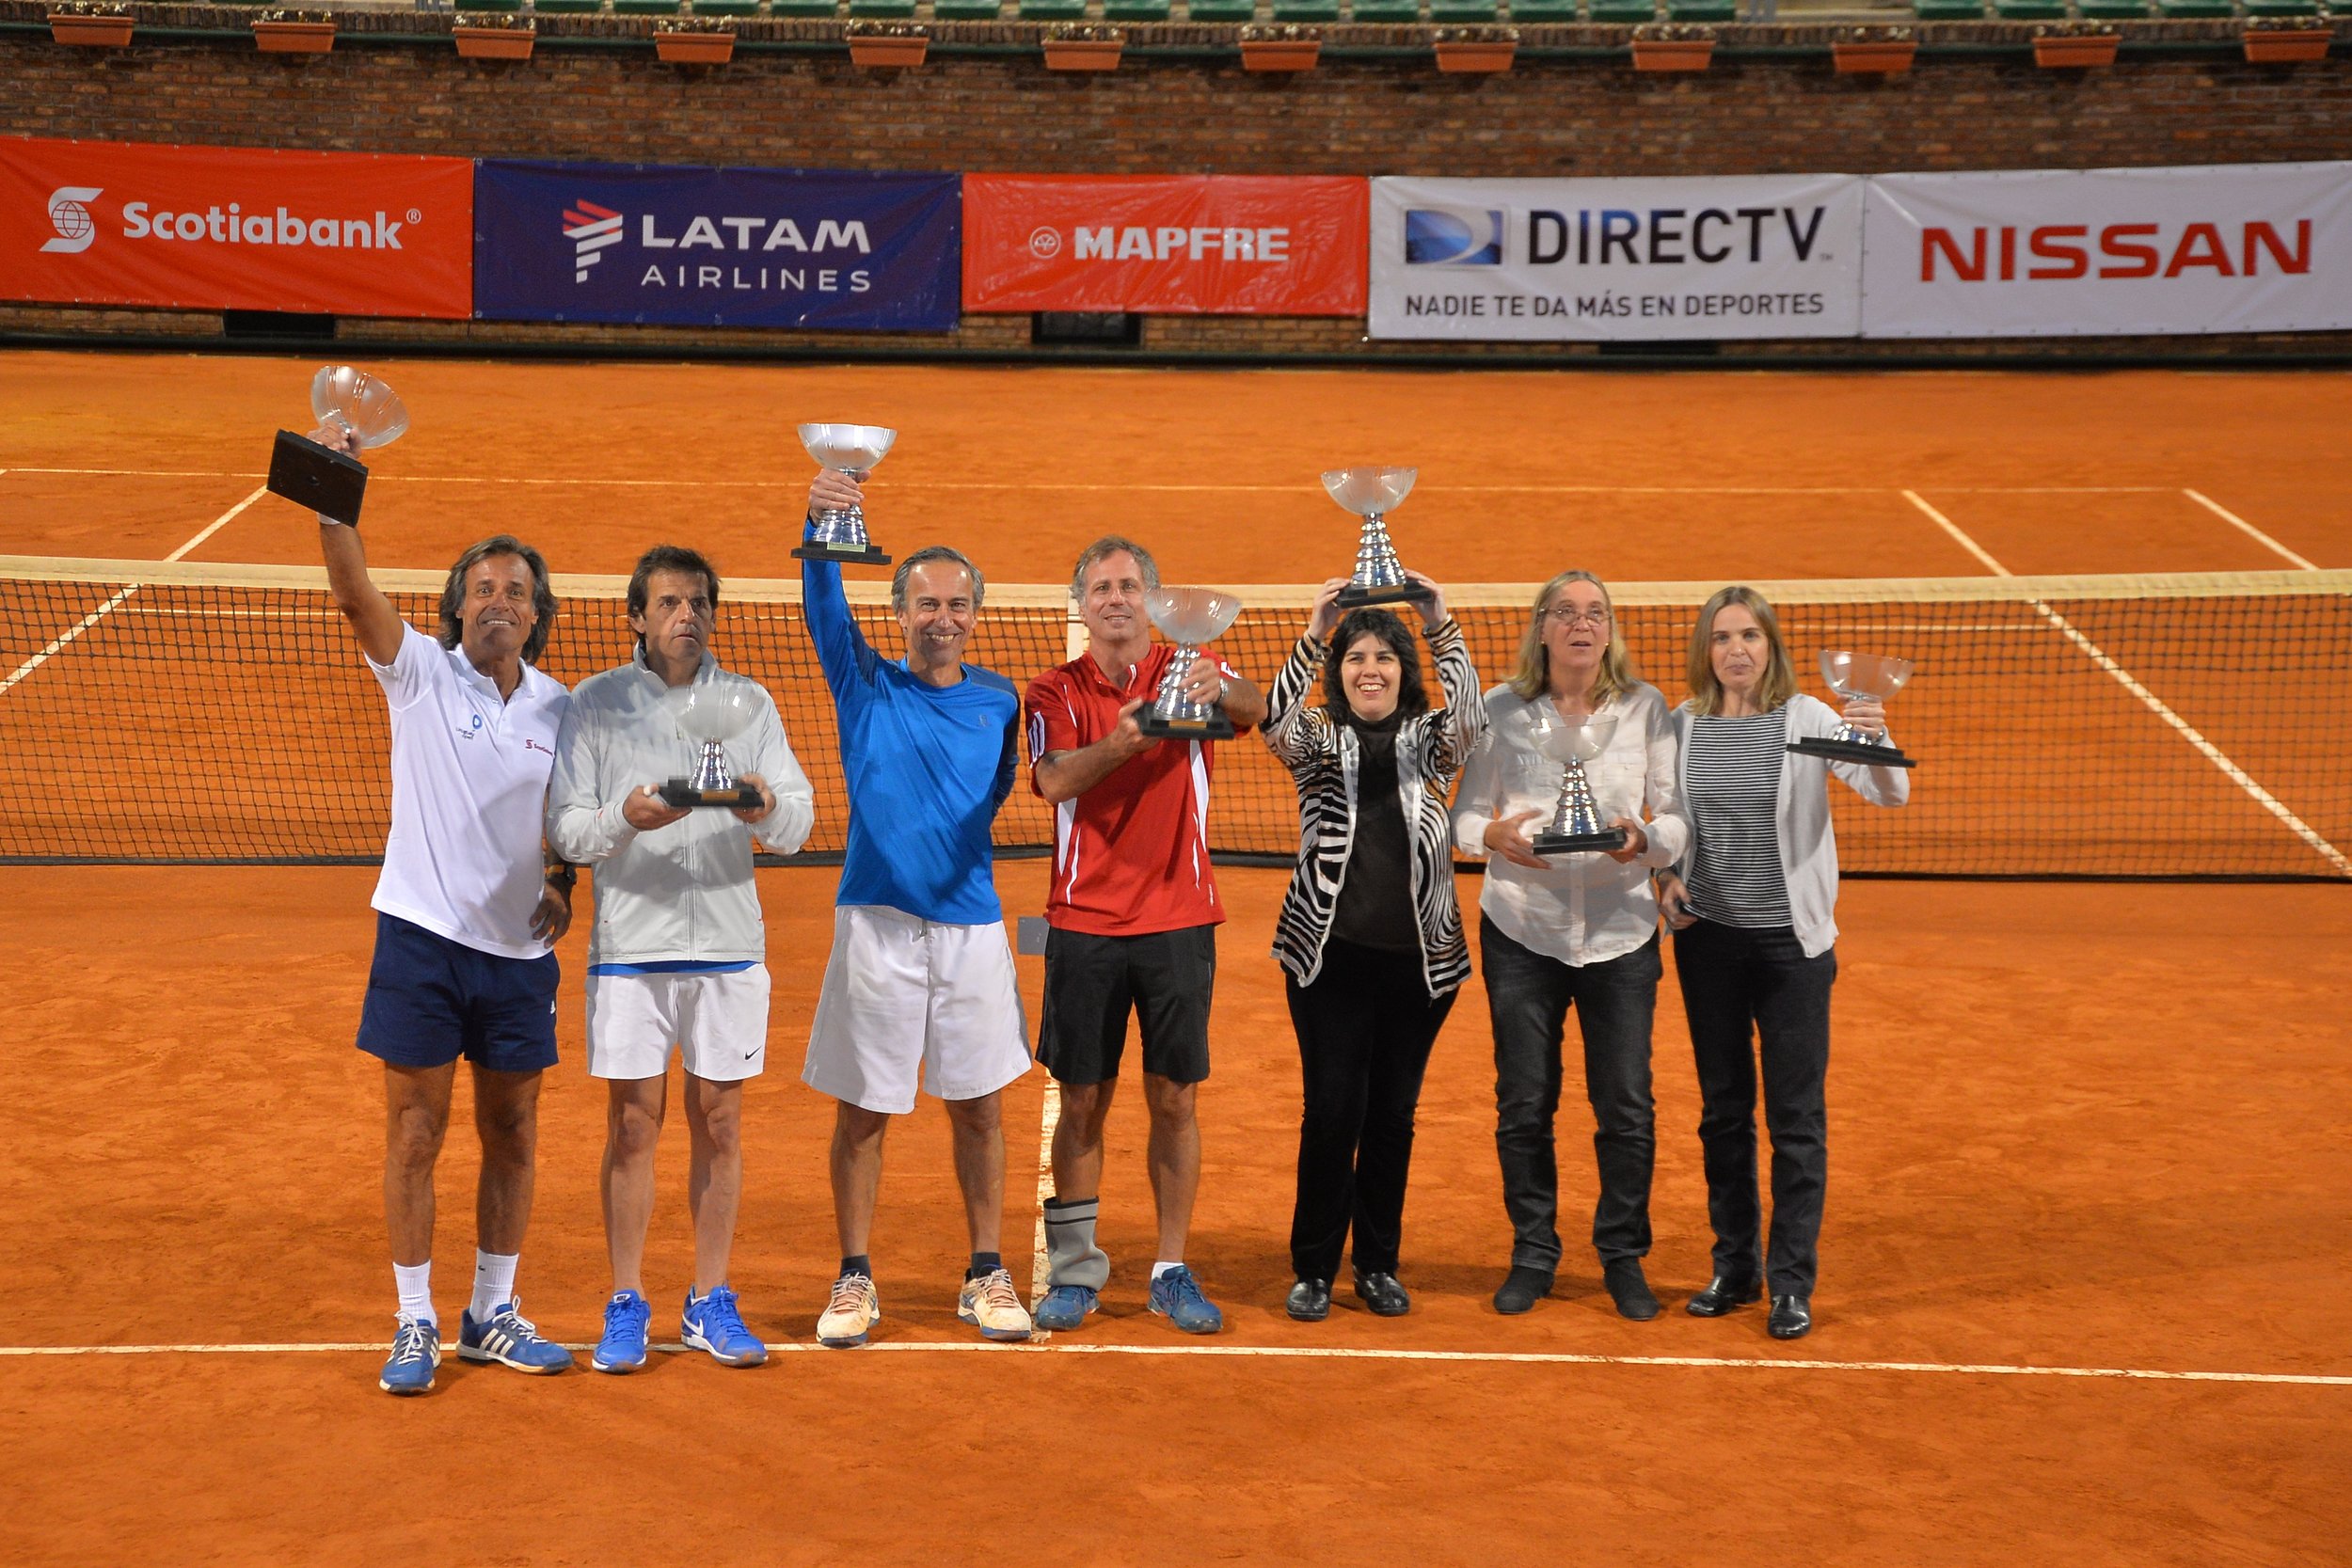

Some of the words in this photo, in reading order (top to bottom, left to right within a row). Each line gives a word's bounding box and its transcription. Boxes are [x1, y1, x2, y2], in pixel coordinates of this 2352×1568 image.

[642, 214, 872, 254] LATAM
[1074, 226, 1290, 261] MAPFRE
[1528, 206, 1826, 264] DIRECTV
[1920, 218, 2312, 282] NISSAN
[642, 263, 872, 293] AIRLINES
[1405, 293, 1486, 318] NADIE
[1496, 292, 1525, 317] TE
[1534, 292, 1570, 317] DA
[1578, 285, 1631, 317] MÁS
[1642, 292, 1676, 316] EN
[1686, 290, 1825, 316] DEPORTES
